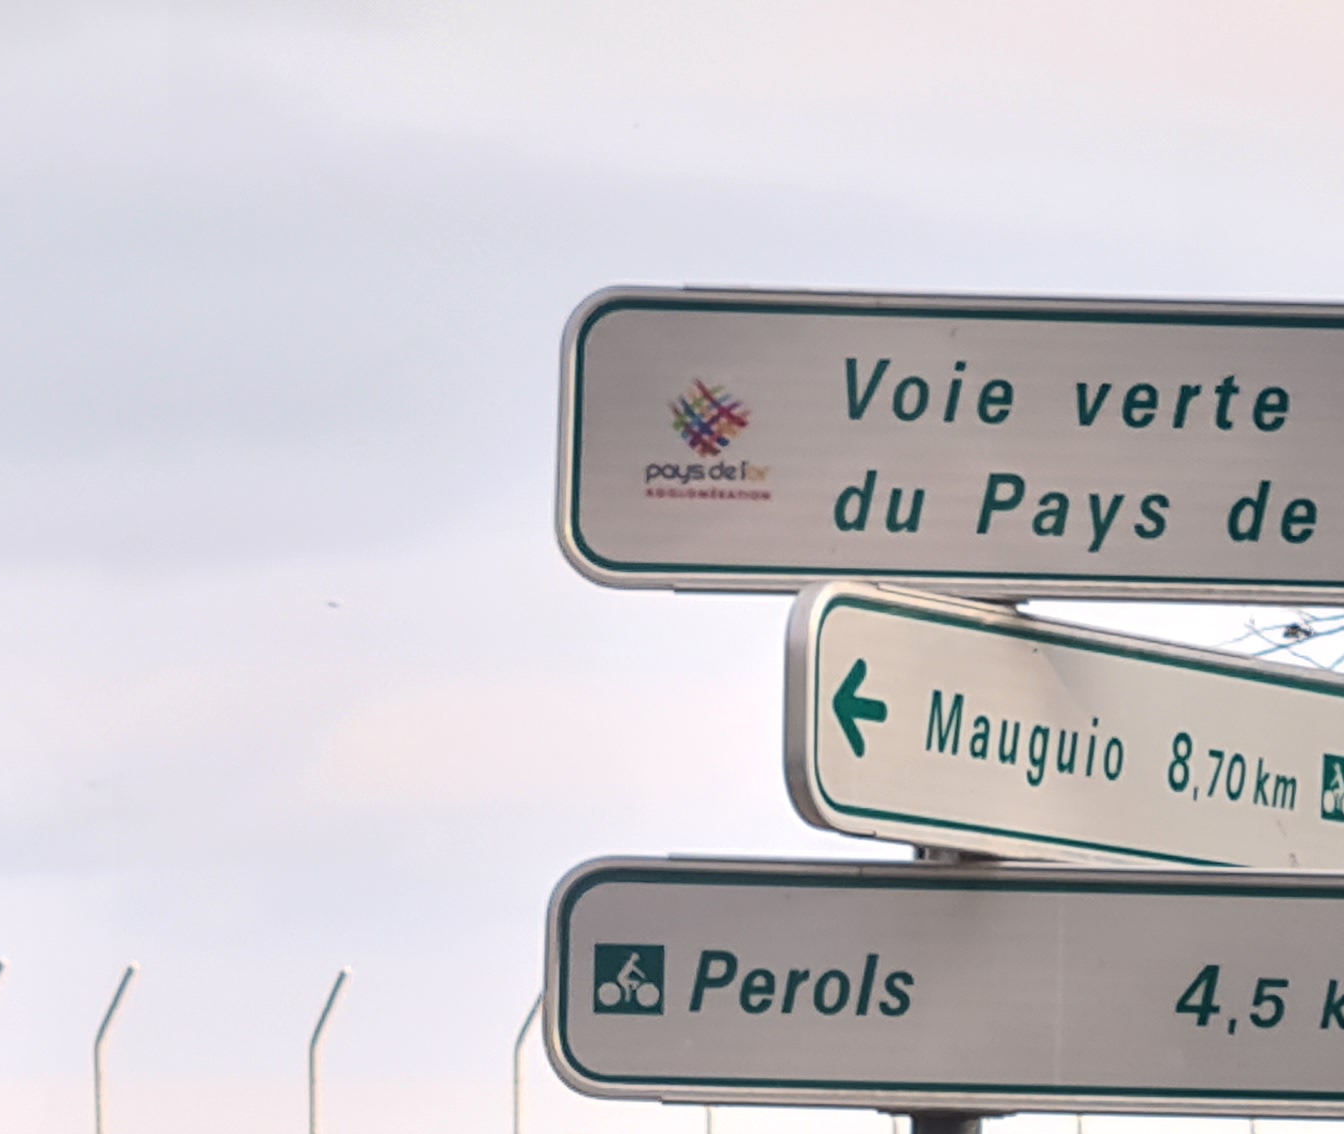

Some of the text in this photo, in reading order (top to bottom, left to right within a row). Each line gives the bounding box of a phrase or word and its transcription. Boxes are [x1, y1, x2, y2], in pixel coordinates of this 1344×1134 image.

[844, 357, 1292, 433] Voie verte
[645, 463, 705, 485] pays
[832, 469, 927, 534] du
[975, 472, 1172, 554] Pays
[1226, 479, 1319, 545] de
[924, 688, 1126, 788] Mauguio
[687, 949, 916, 1017] Perols
[1173, 964, 1291, 1036] 4,5
